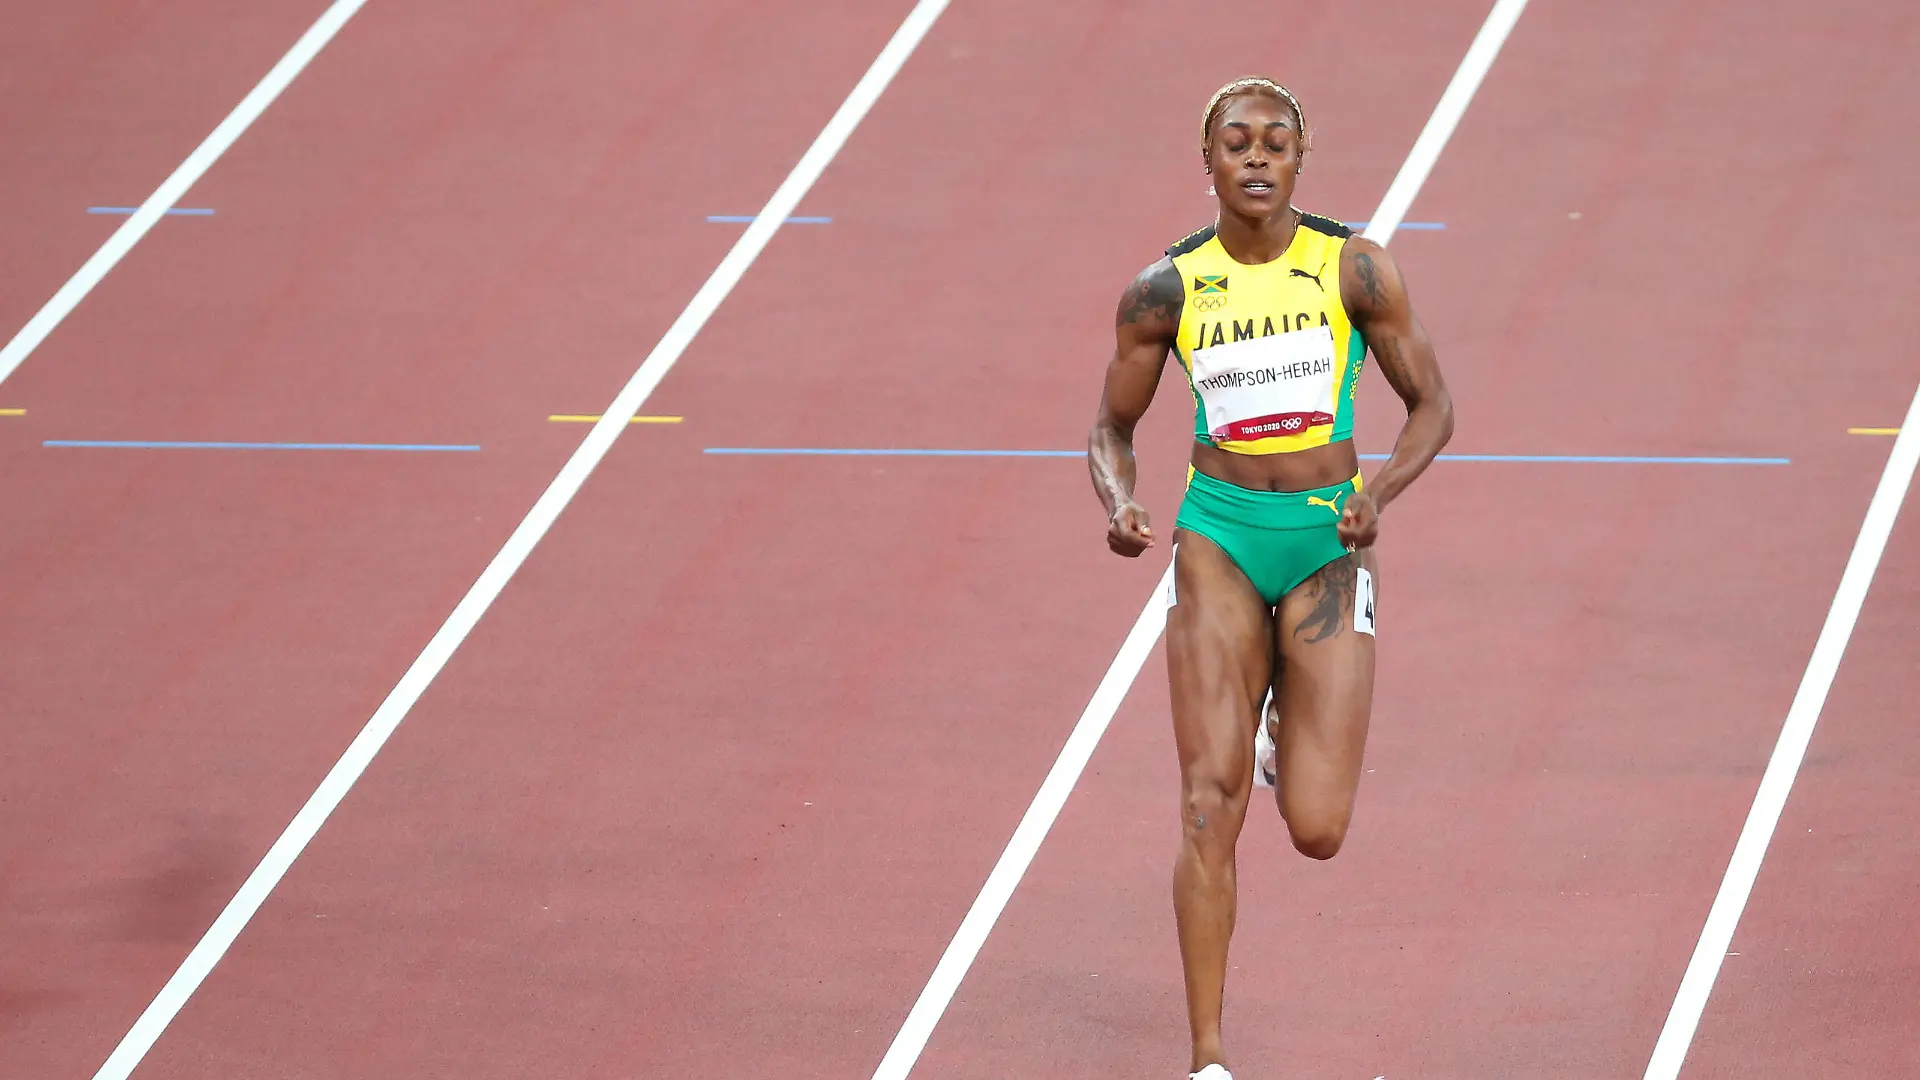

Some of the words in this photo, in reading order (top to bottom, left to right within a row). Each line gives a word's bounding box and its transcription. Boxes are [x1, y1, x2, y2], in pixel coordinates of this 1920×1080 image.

[1193, 311, 1333, 350] JAMAICA
[1199, 357, 1331, 390] THOMPSON-HERAH
[1241, 424, 1262, 435] TOKYO
[1262, 422, 1280, 432] 2020
